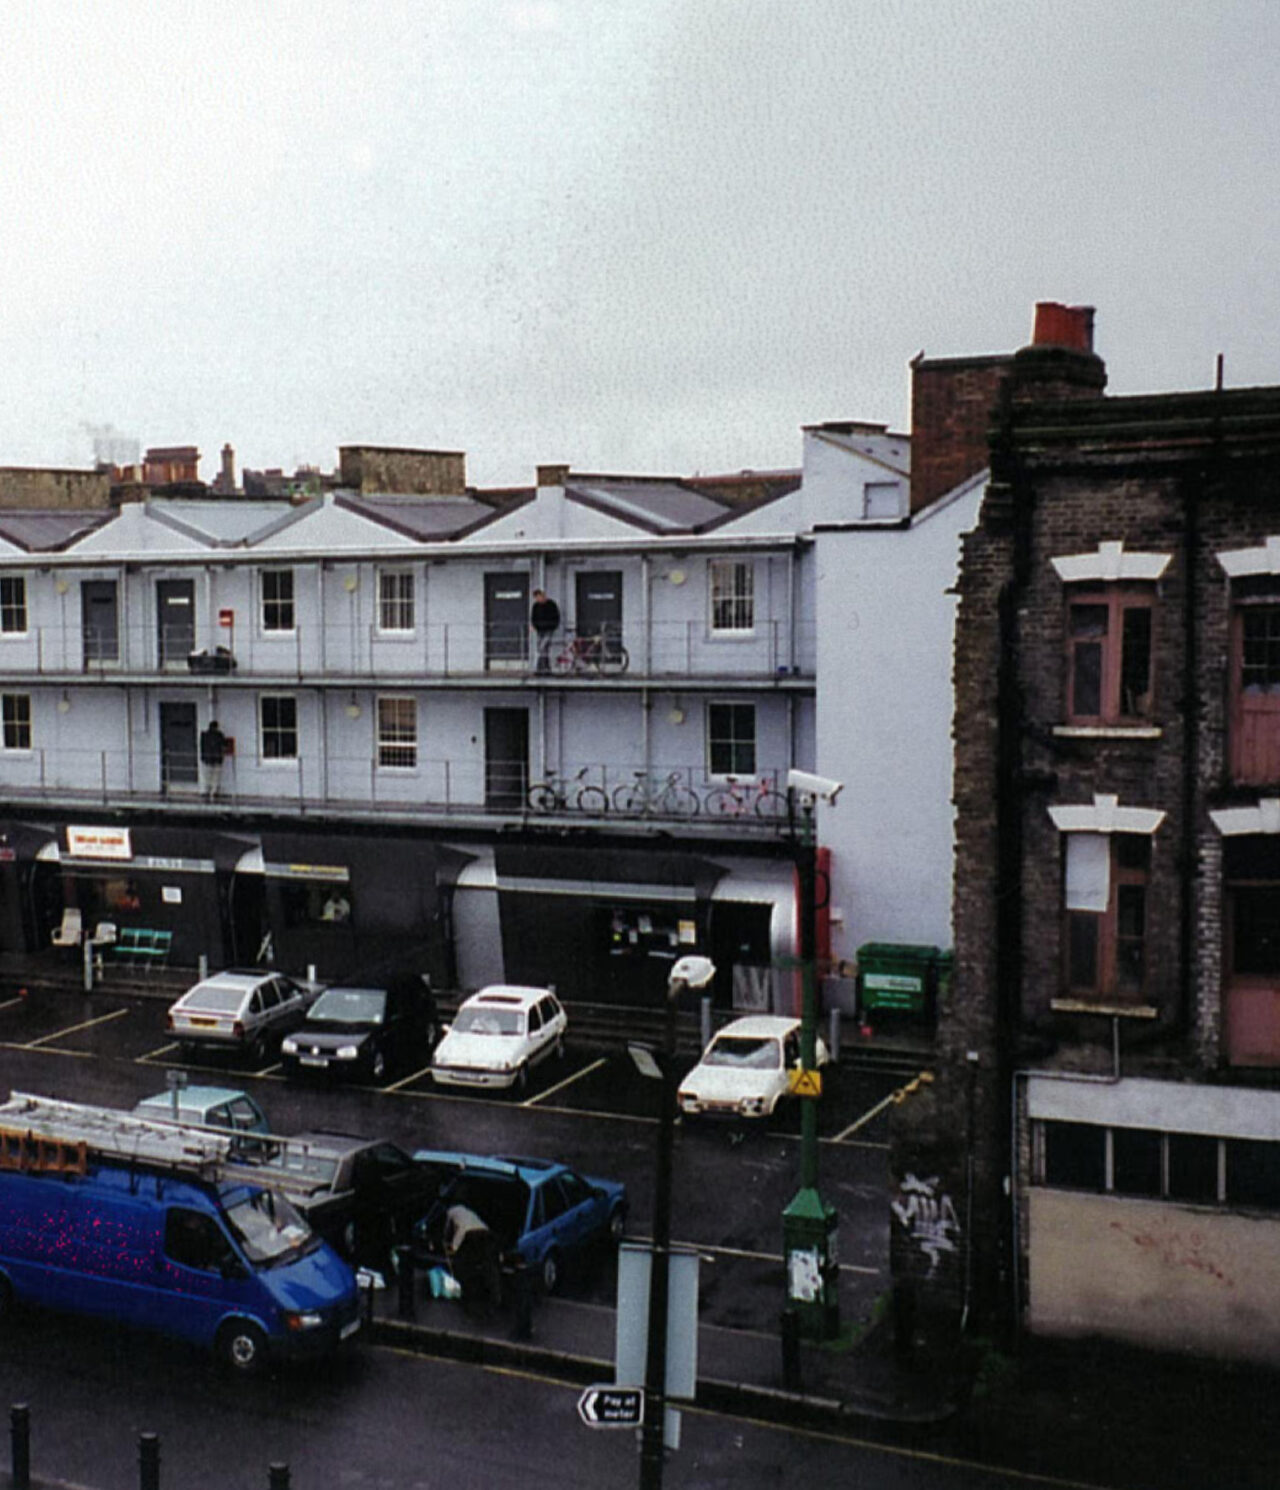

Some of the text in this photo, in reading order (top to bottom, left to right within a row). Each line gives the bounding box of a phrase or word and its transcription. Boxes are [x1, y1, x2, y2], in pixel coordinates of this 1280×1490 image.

[604, 1395, 636, 1407] Pay at
[604, 1409, 634, 1418] meter
